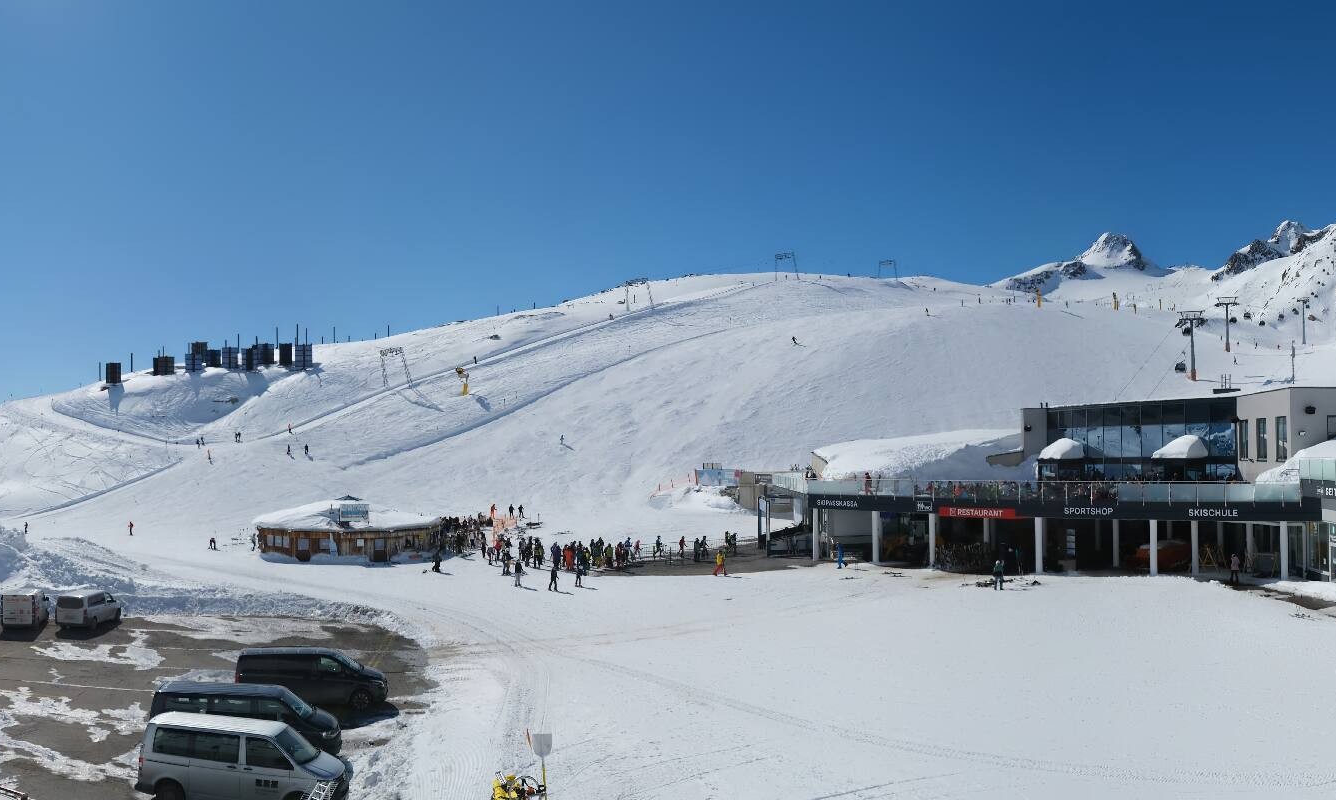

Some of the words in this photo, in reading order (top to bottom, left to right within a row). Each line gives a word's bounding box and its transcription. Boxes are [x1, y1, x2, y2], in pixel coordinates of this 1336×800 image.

[957, 508, 1004, 517] RESTAURANT
[1063, 507, 1114, 516] SPORTSHOP
[1188, 508, 1239, 517] SKISCHULE
